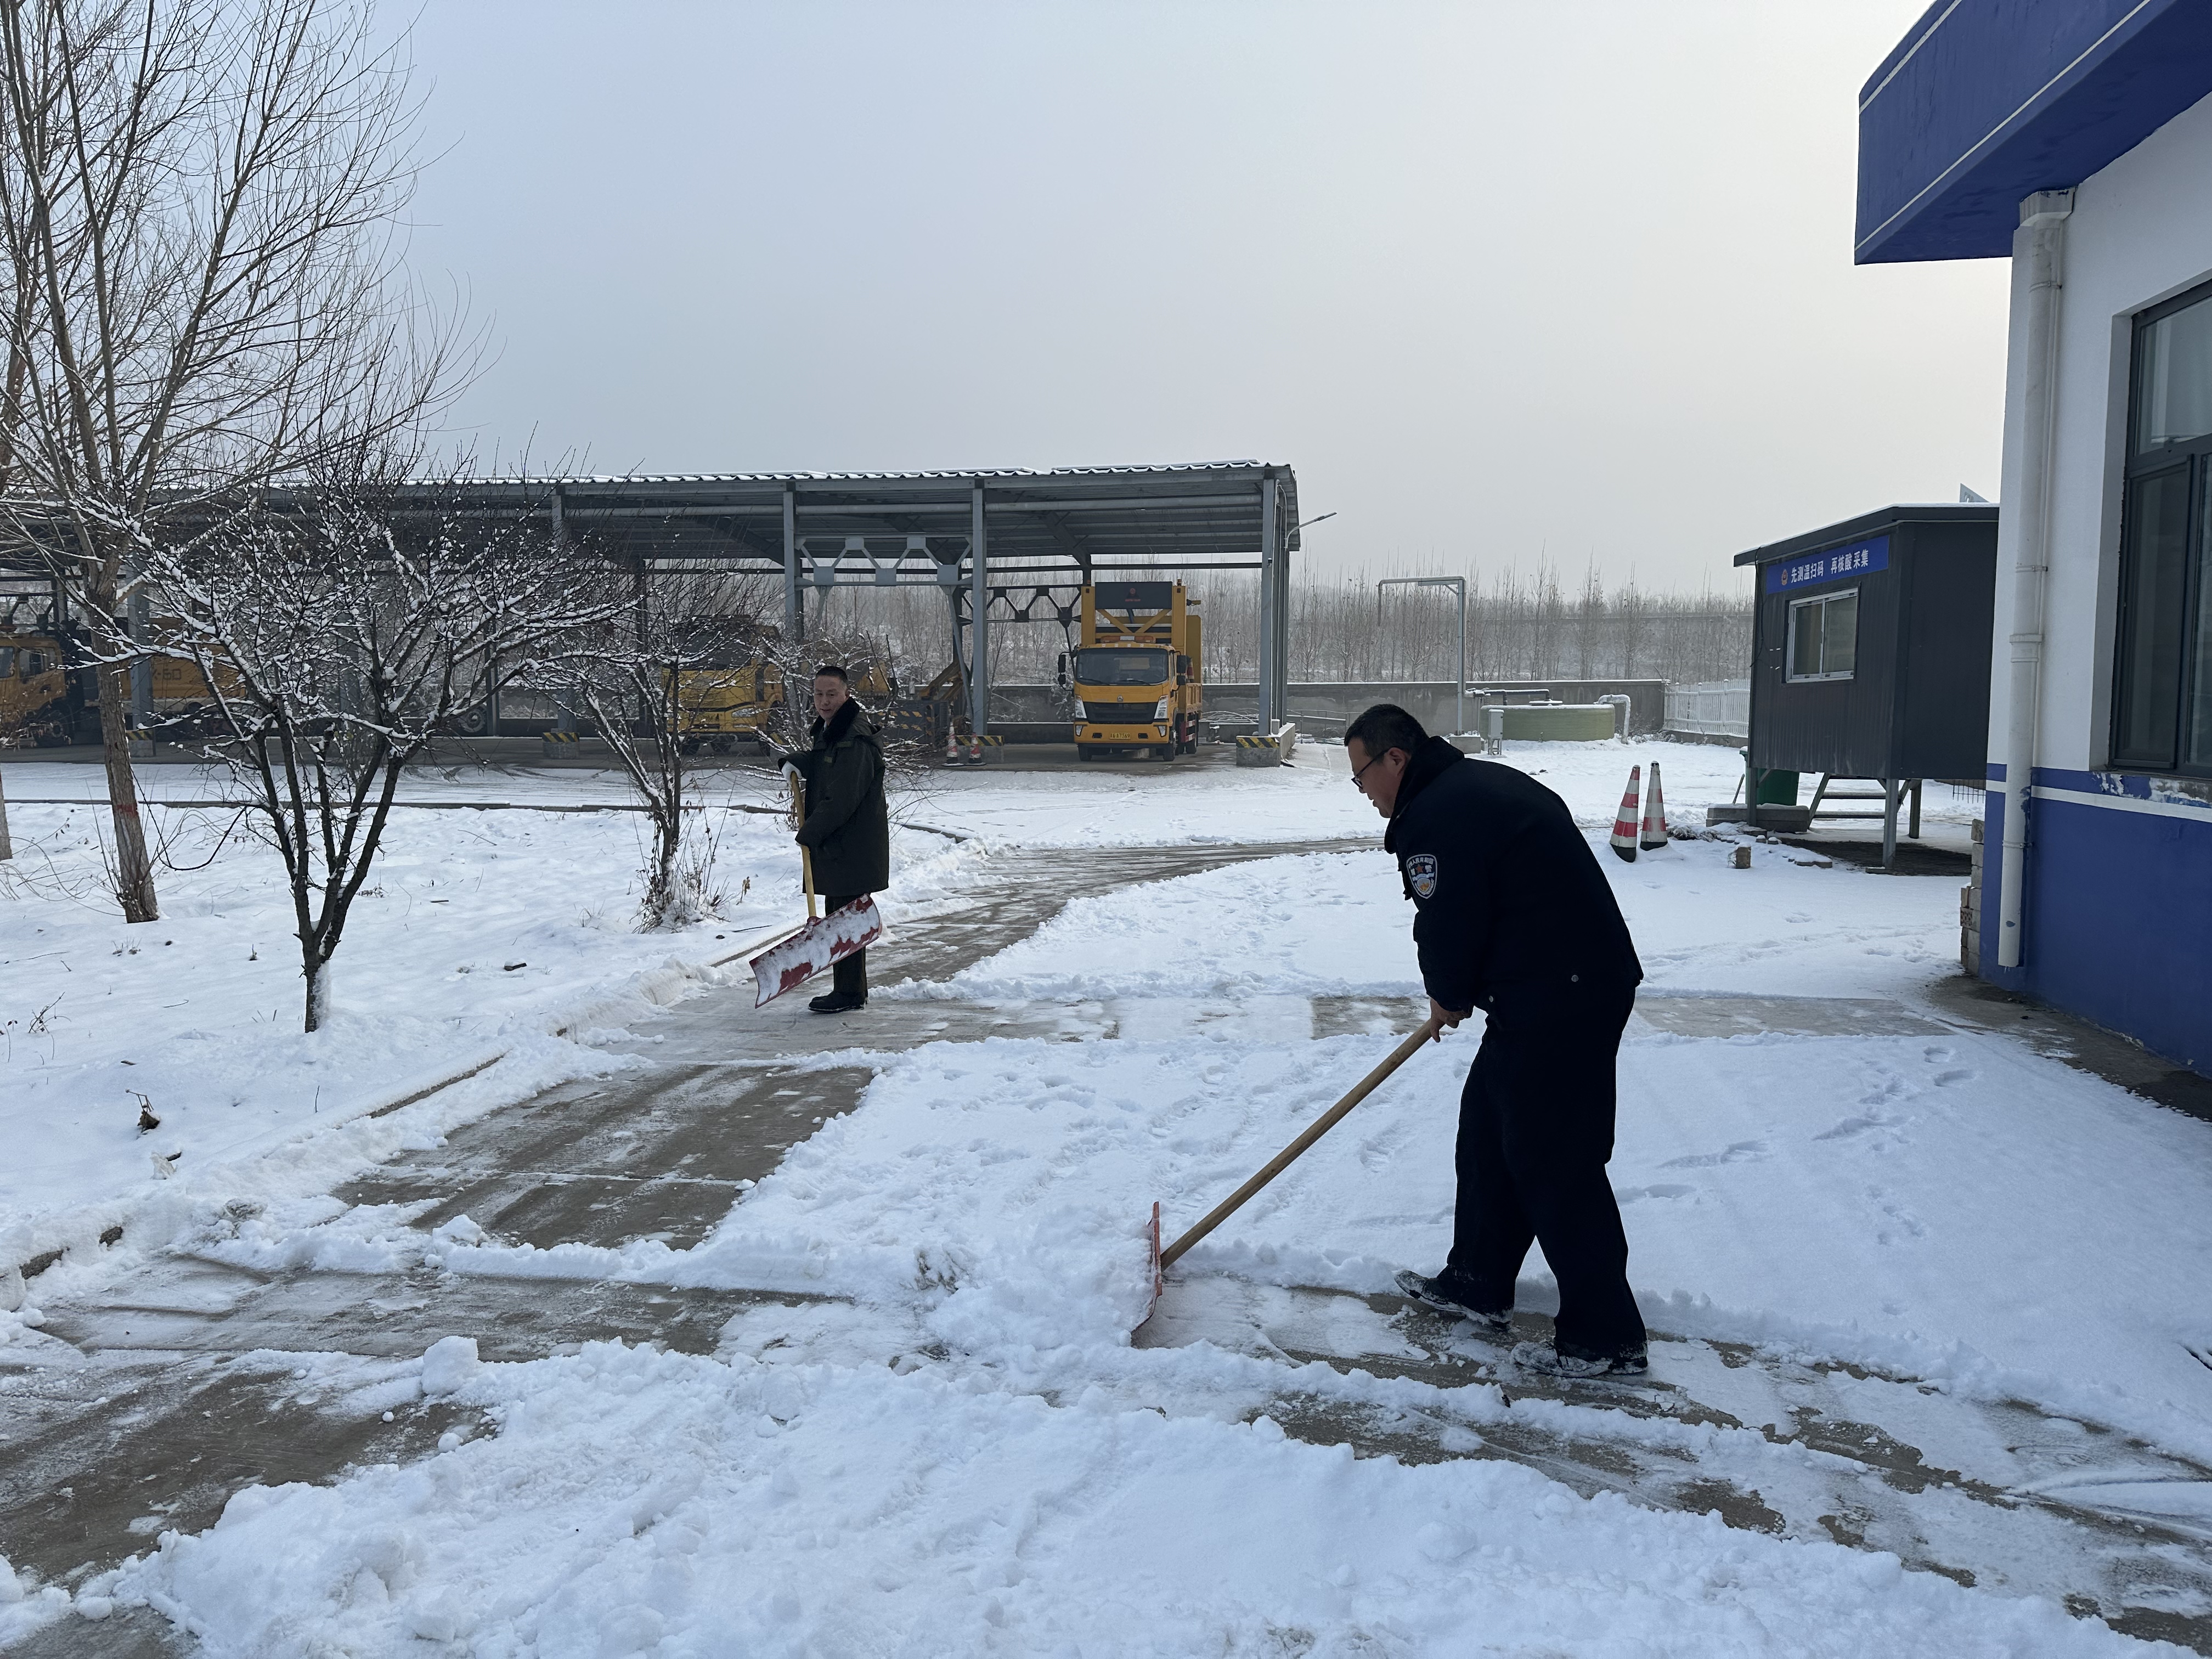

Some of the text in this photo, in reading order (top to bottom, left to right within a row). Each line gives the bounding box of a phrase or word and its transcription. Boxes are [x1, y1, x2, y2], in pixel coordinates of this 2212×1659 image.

[1791, 549, 1869, 583] 先测温扫码 再核酸采集
